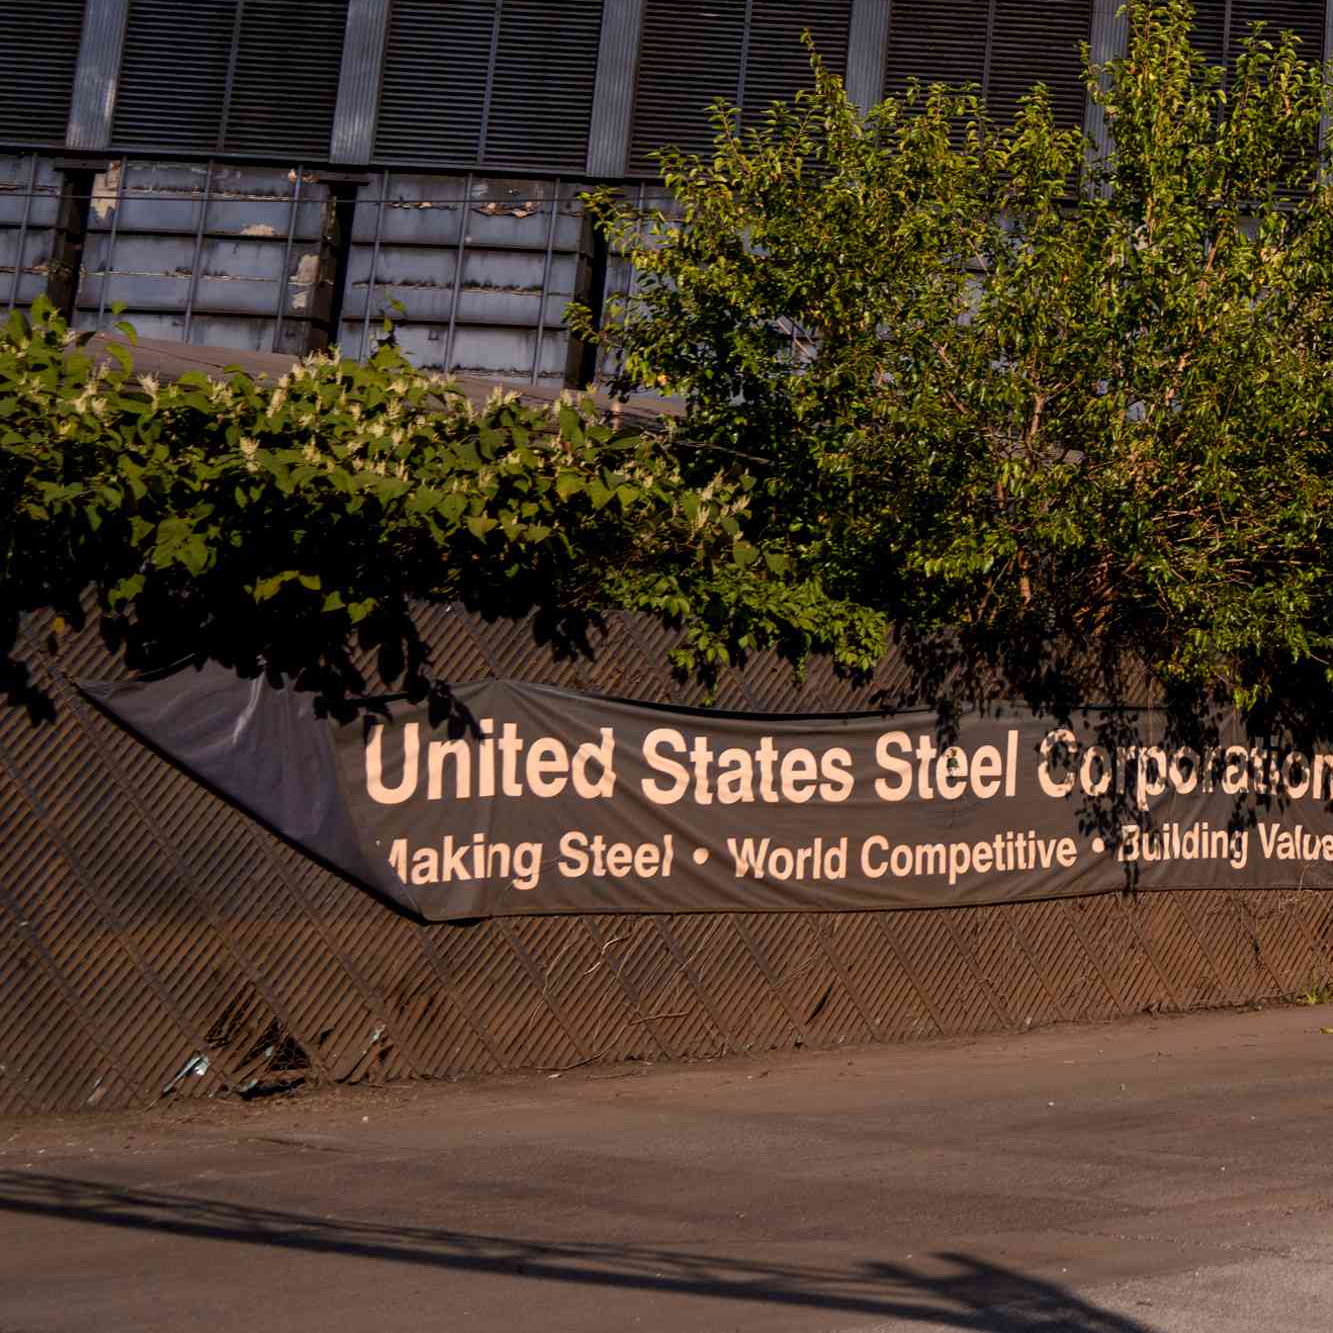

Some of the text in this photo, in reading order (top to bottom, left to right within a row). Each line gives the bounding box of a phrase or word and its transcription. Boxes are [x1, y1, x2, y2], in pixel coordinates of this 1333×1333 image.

[365, 718, 617, 805] United
[641, 727, 856, 806] States
[874, 729, 1019, 802] Steel
[557, 830, 674, 879] Steel
[727, 835, 849, 880] World
[861, 830, 1077, 885] Competitive
[1117, 821, 1248, 869] Building
